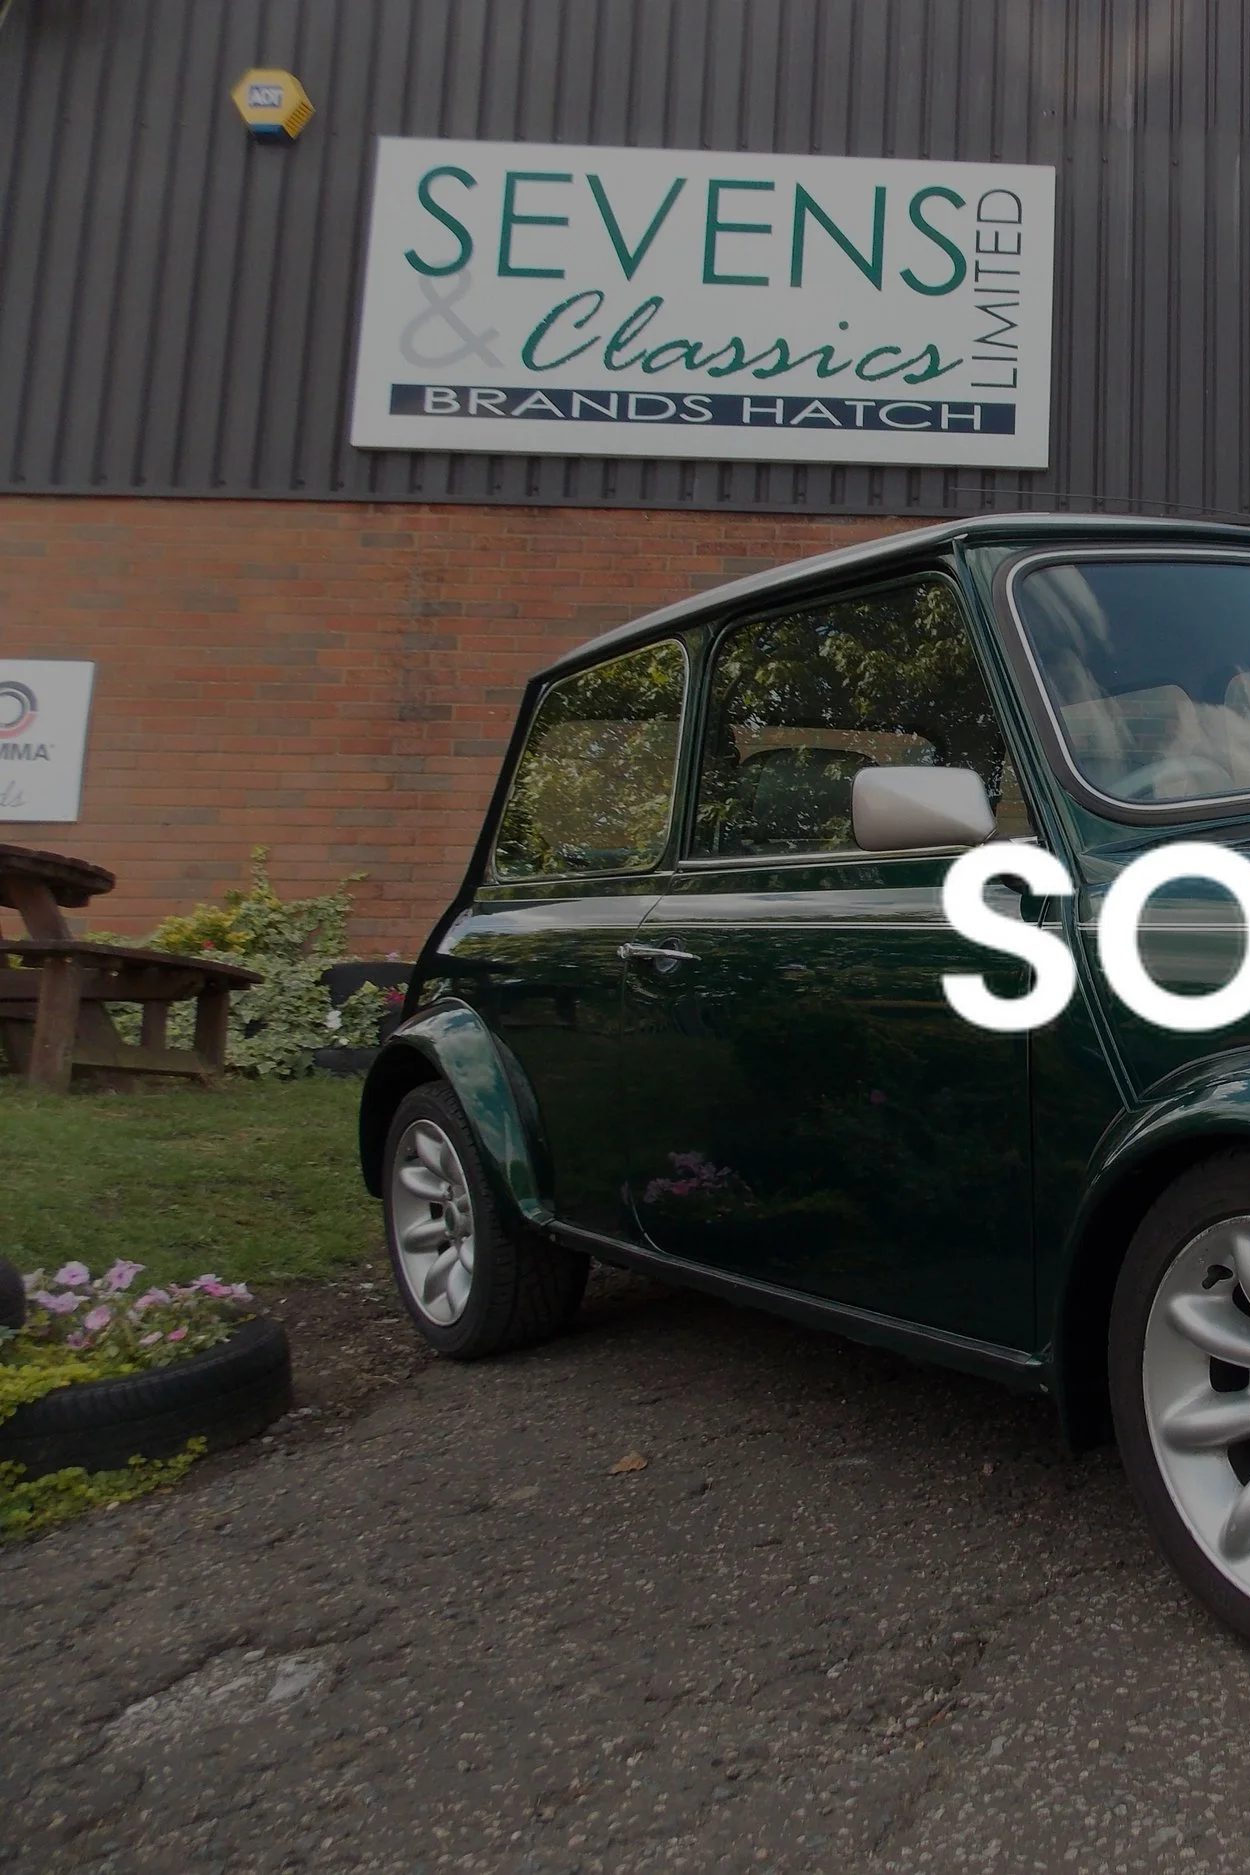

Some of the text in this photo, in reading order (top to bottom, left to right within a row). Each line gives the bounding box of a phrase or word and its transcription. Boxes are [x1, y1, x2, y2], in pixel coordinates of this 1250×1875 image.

[404, 165, 967, 296] SEVENS
[970, 188, 1023, 390] LIMITED
[399, 258, 965, 385] & Classics
[422, 386, 983, 431] BRANDS HATCH
